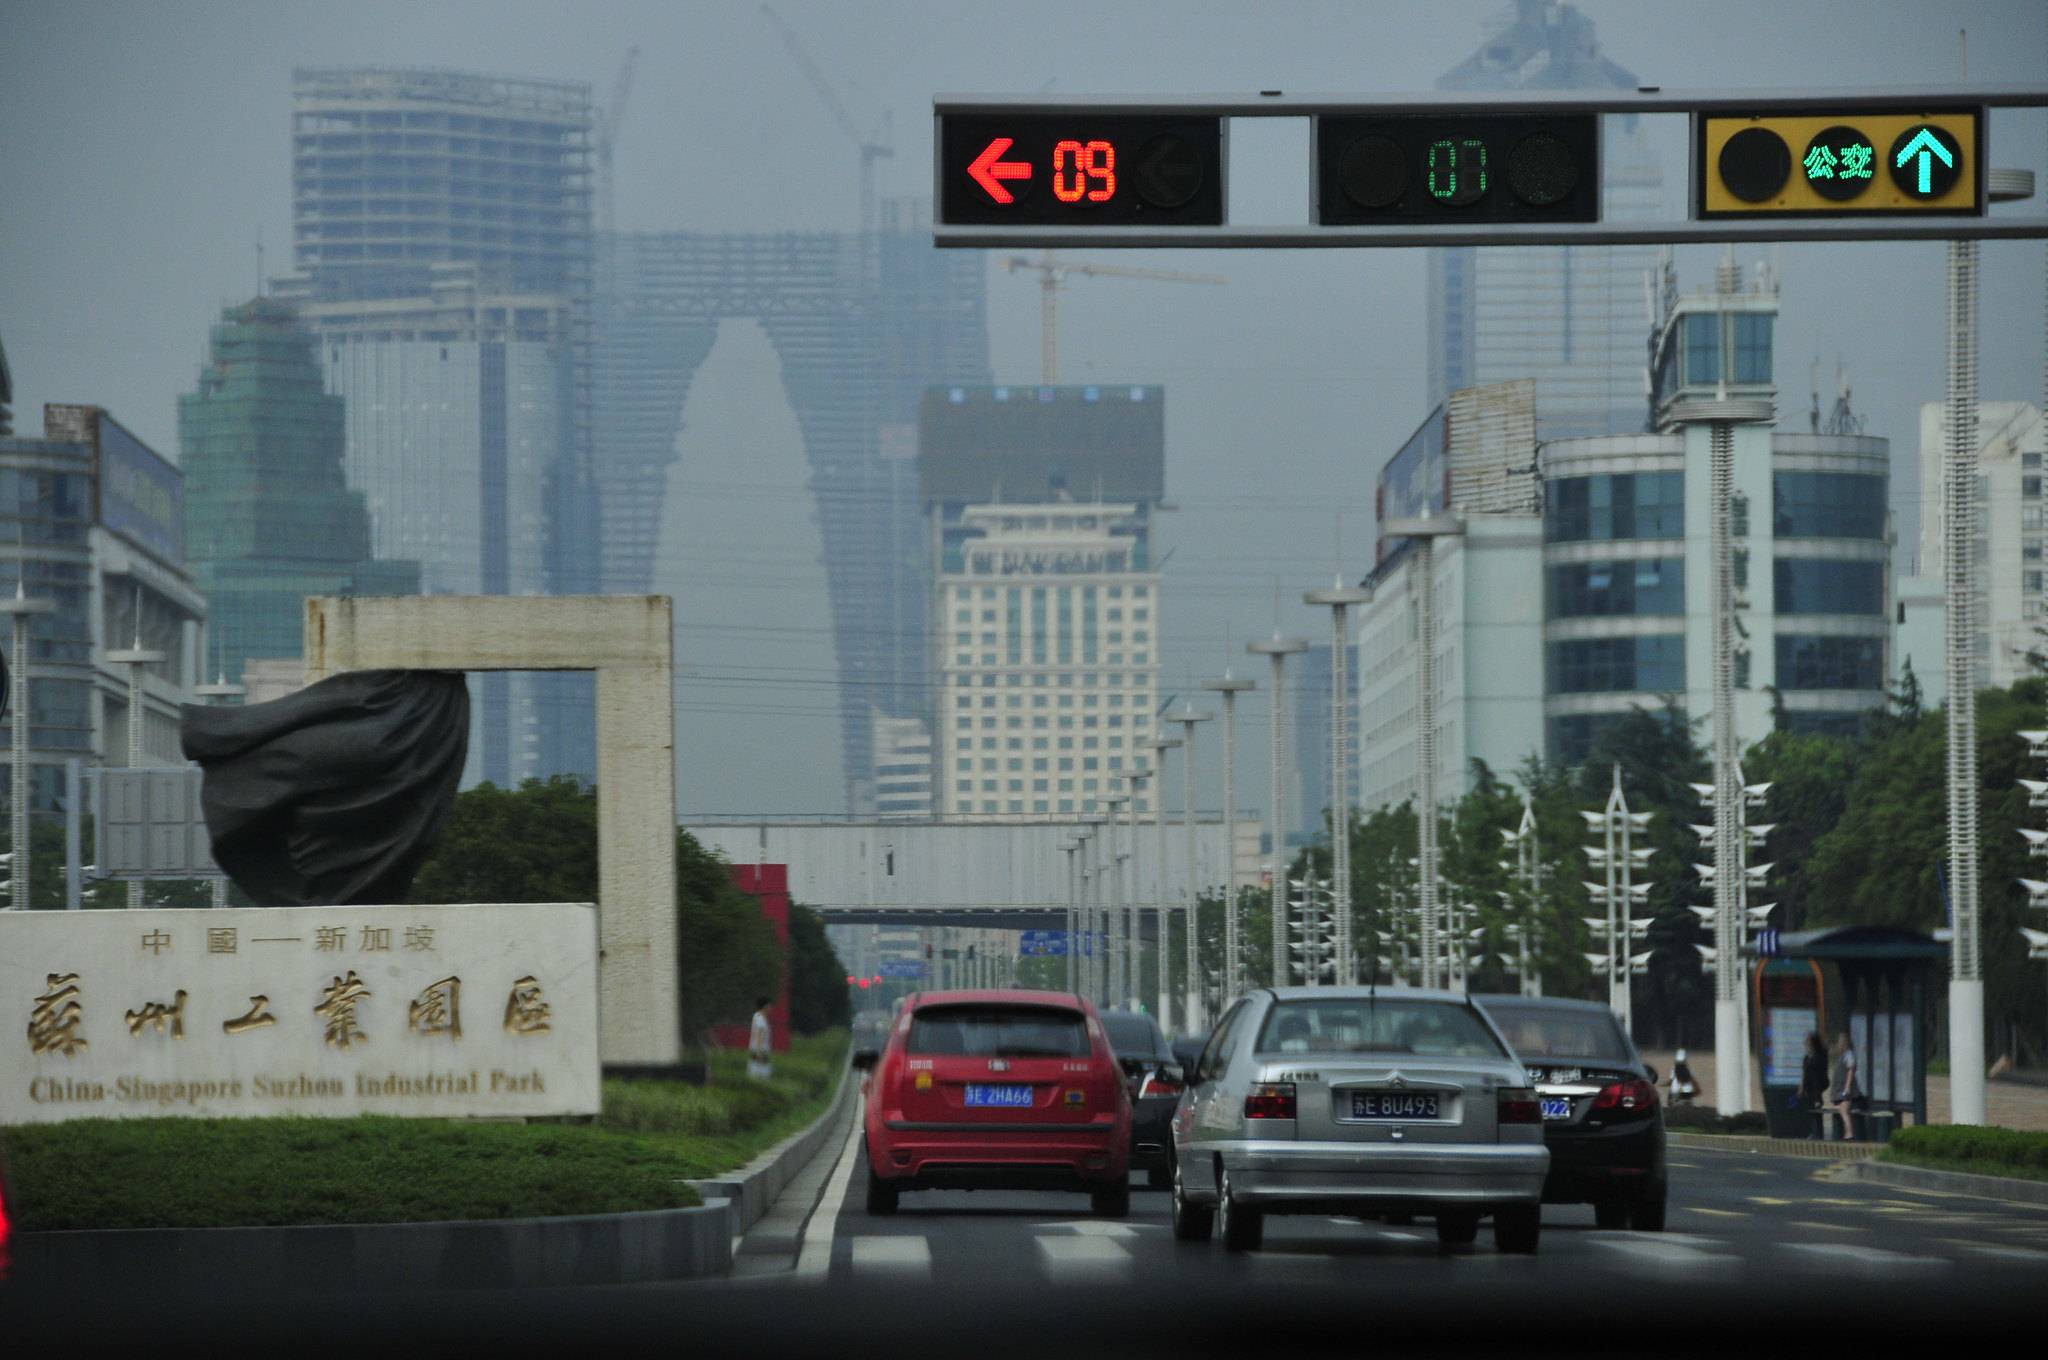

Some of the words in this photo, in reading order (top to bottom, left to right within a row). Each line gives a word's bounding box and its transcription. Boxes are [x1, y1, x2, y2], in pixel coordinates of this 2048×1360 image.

[1053, 140, 1115, 201] 09
[1428, 139, 1487, 197] 07
[1803, 143, 1872, 179] 公交
[29, 1073, 243, 1105] China-Singapore
[252, 1070, 344, 1098] Suzhou
[355, 1069, 478, 1097] Industrial
[490, 1067, 545, 1095] Park
[1381, 1096, 1437, 1115] 8U493
